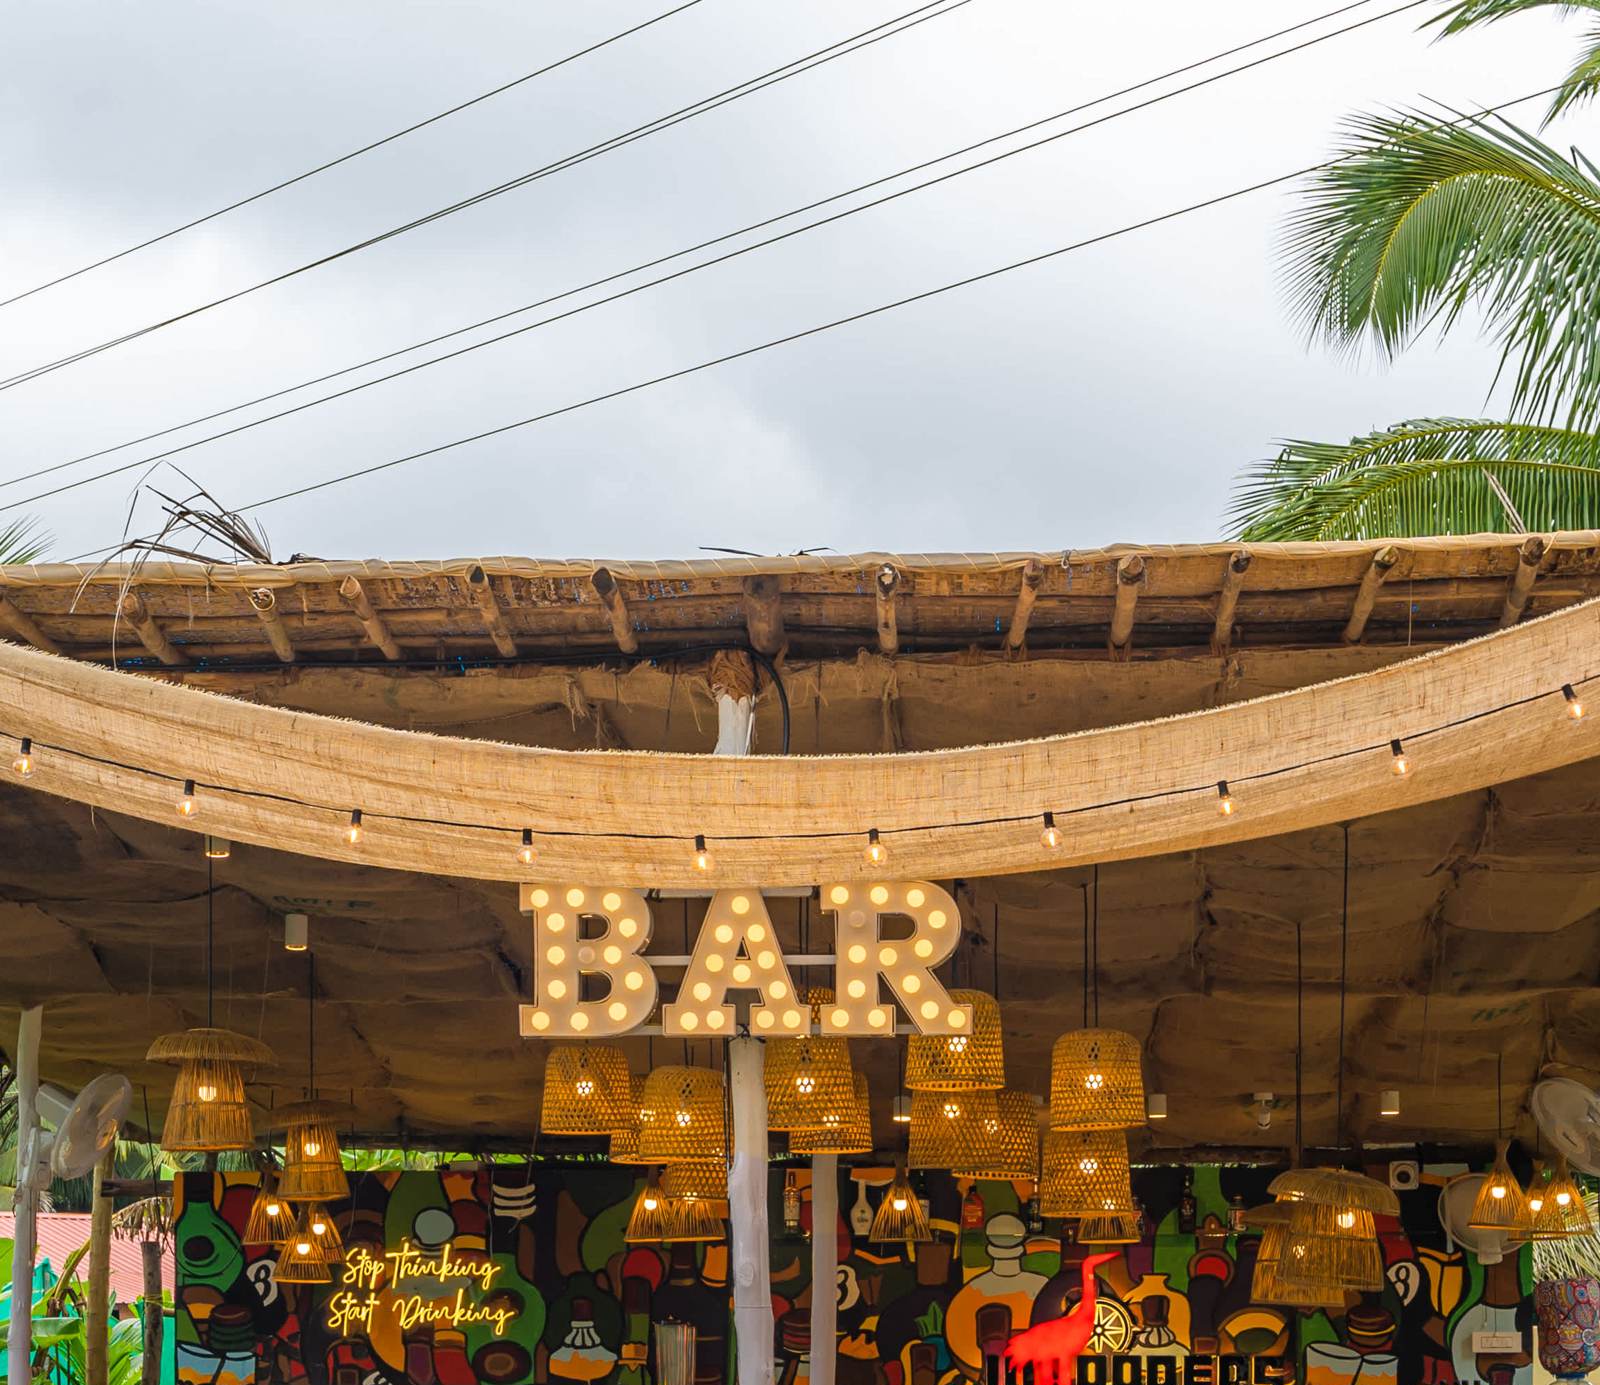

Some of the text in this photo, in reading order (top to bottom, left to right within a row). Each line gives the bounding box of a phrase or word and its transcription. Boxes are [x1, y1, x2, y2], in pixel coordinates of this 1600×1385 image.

[519, 881, 974, 1038] BAR
[343, 1242, 501, 1291] Stop Thinking
[327, 1288, 515, 1336] Start Drinking
